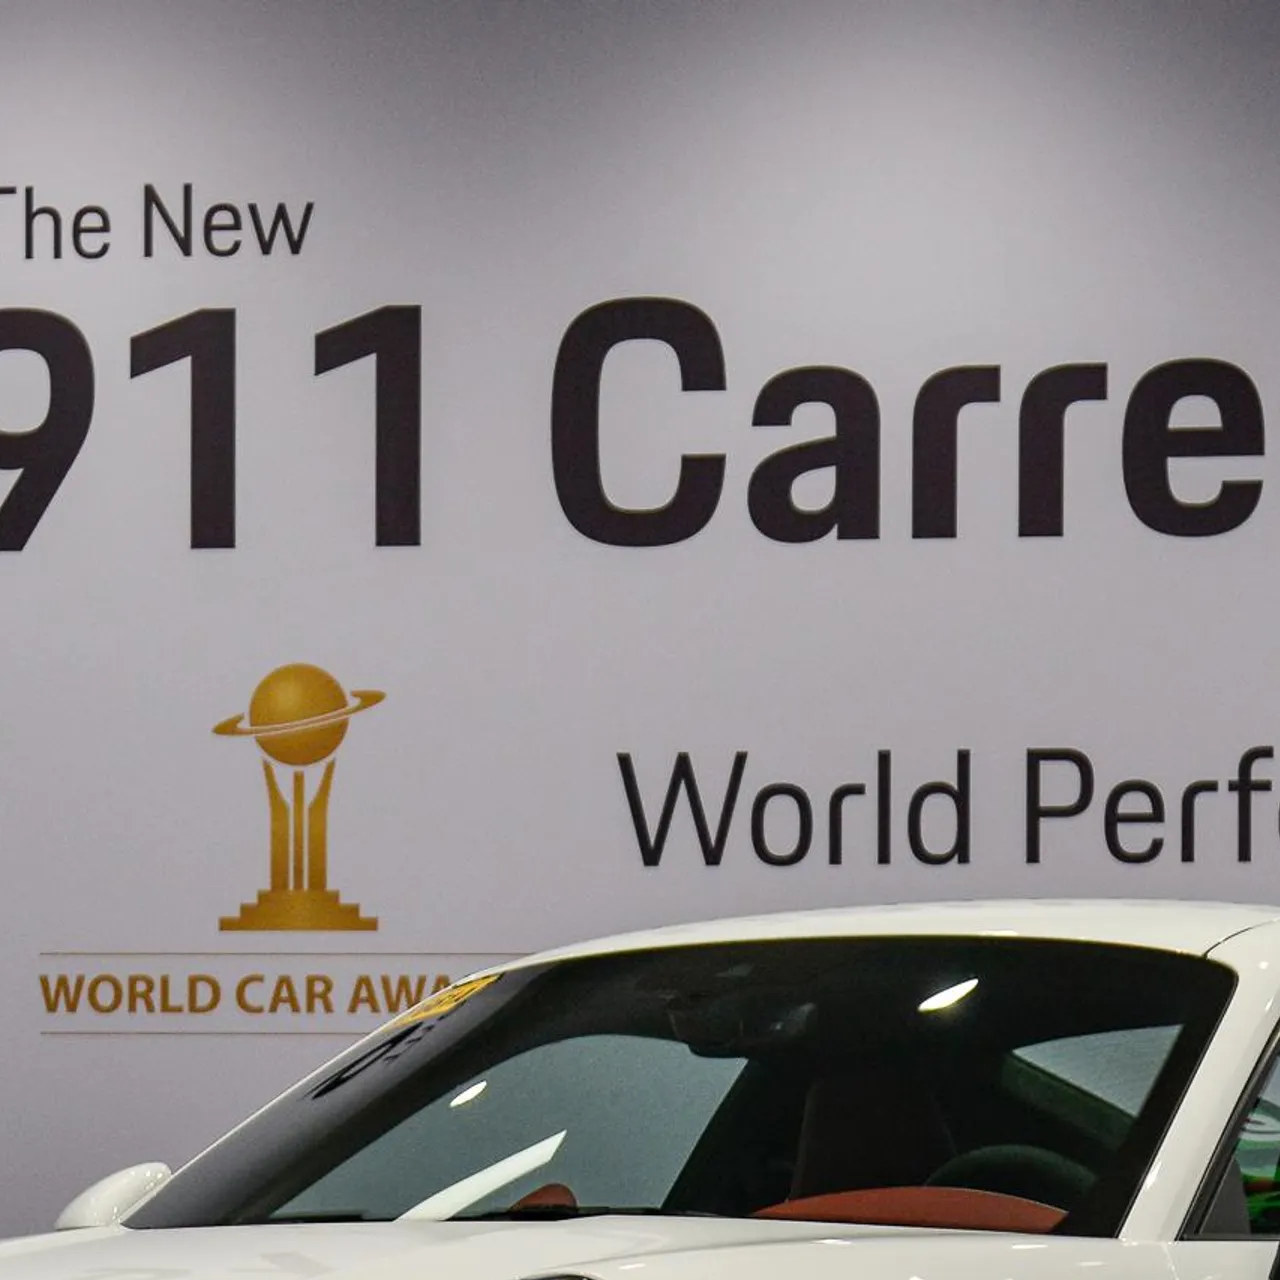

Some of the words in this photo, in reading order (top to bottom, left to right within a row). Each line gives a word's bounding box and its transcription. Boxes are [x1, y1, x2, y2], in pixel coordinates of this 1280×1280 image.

[144, 183, 315, 258] New
[616, 749, 971, 867] World
[39, 974, 222, 1014] WORLD
[235, 974, 334, 1015] CAR
